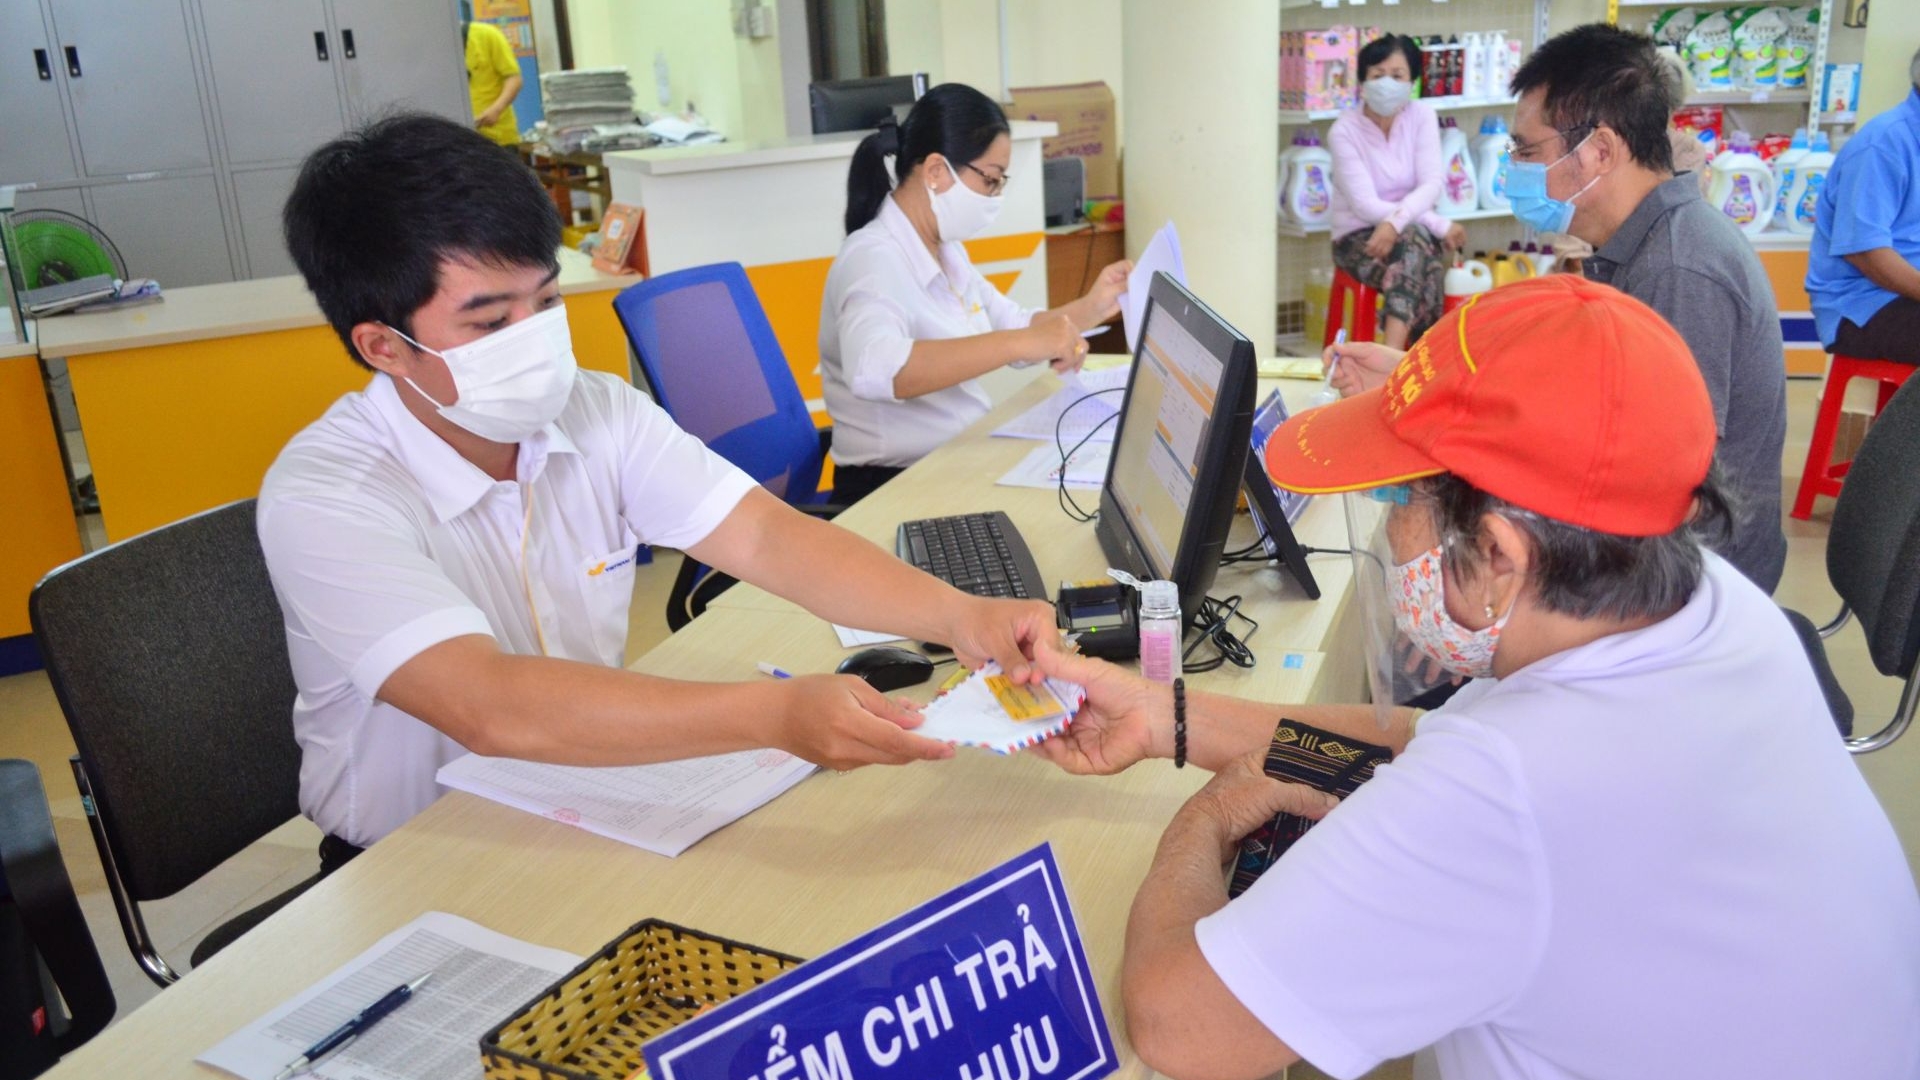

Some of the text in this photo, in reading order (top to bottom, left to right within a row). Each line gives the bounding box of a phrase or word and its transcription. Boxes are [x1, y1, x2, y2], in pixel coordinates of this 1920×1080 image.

[747, 903, 1057, 1080] ỂM CHI TRẢ
[959, 1014, 1060, 1080] HƯU
